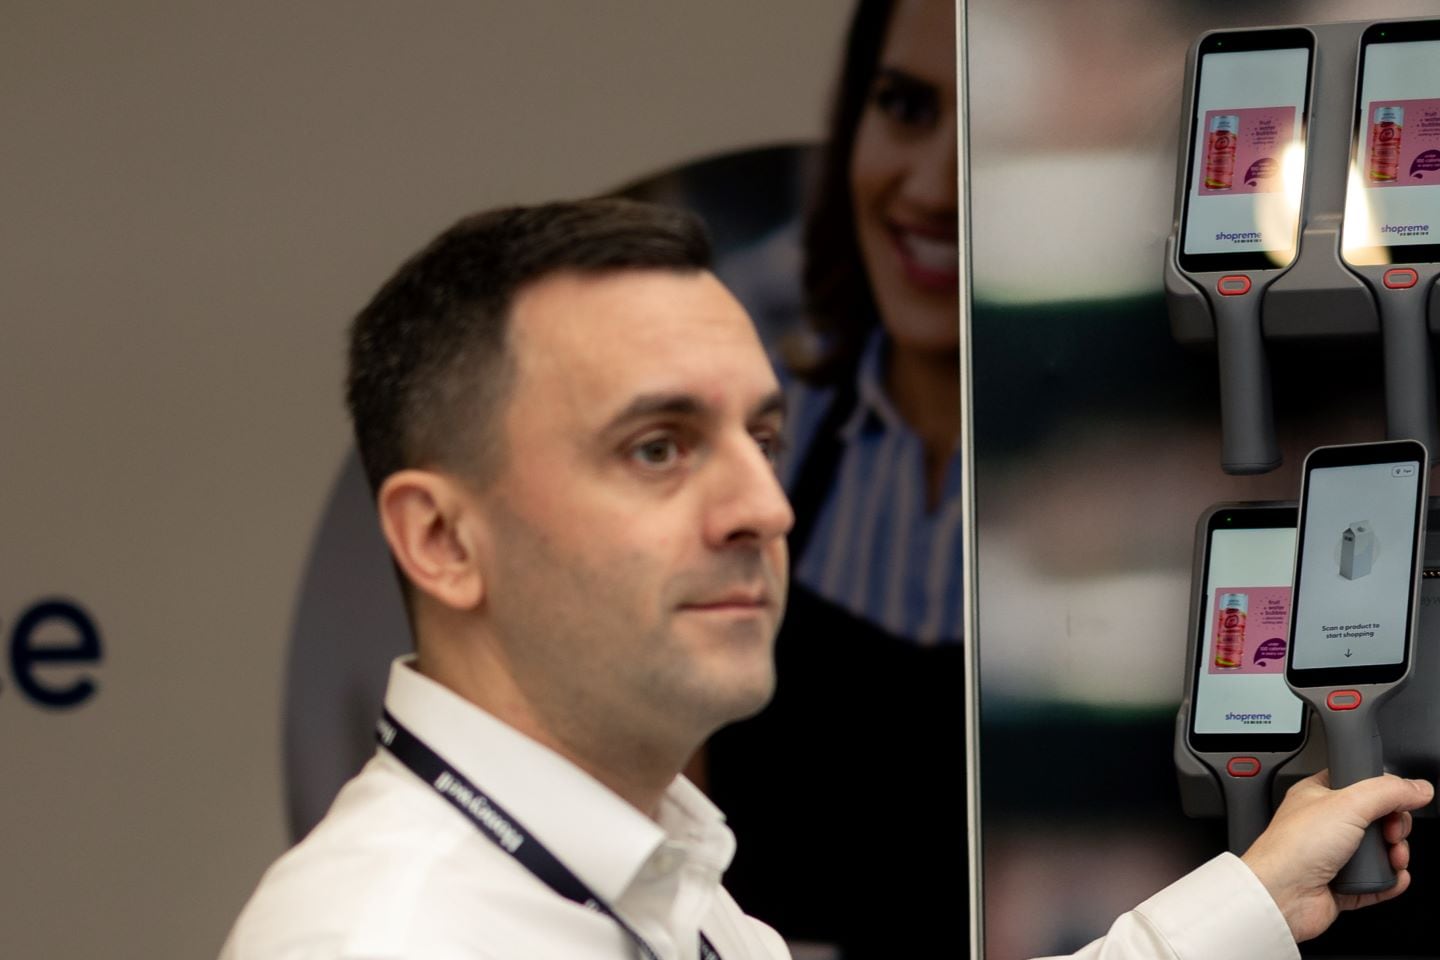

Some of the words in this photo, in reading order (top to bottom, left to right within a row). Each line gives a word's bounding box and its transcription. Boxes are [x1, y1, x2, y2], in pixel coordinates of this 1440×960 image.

[1345, 623, 1372, 632] product
[1343, 630, 1374, 639] shopping
[0, 596, 104, 711] e
[1225, 712, 1272, 722] shopreme
